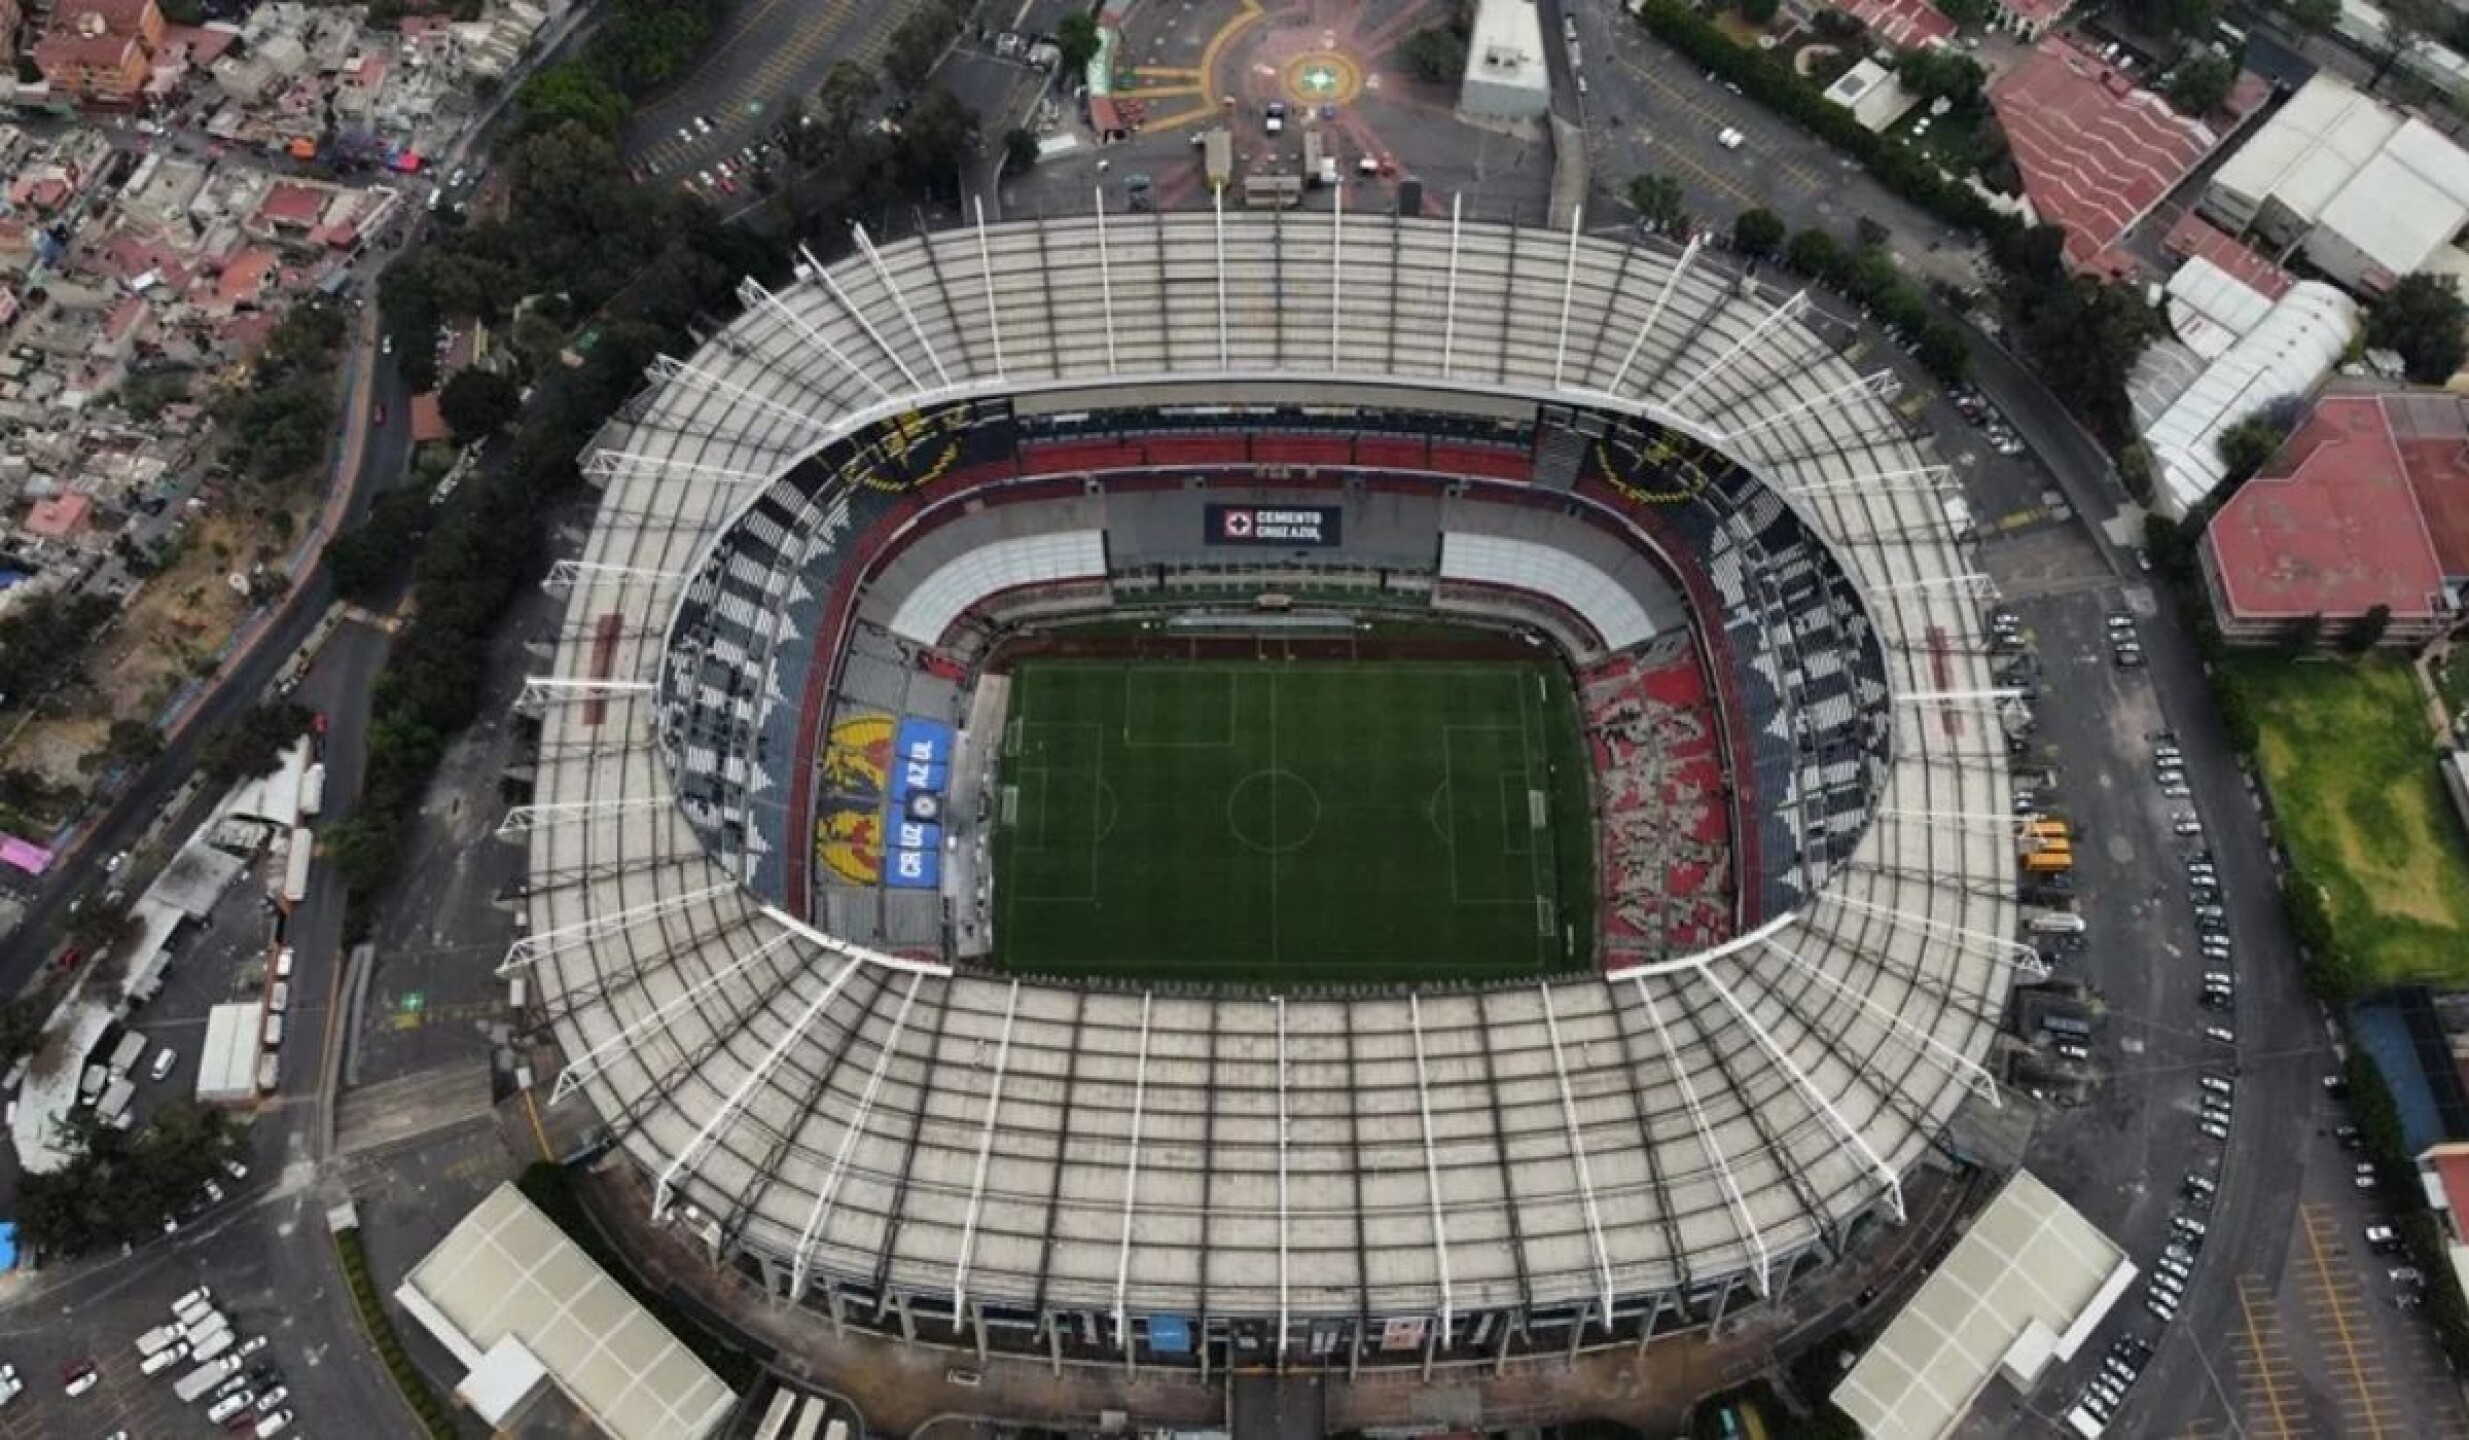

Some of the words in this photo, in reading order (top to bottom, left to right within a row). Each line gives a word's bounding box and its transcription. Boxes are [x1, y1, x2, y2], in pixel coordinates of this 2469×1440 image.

[1256, 510, 1321, 524] CEMENTO
[1256, 525, 1287, 538] CRUZ
[1291, 525, 1322, 541] AZUL
[906, 740, 932, 788] AZUL
[899, 822, 923, 878] CRUZ
